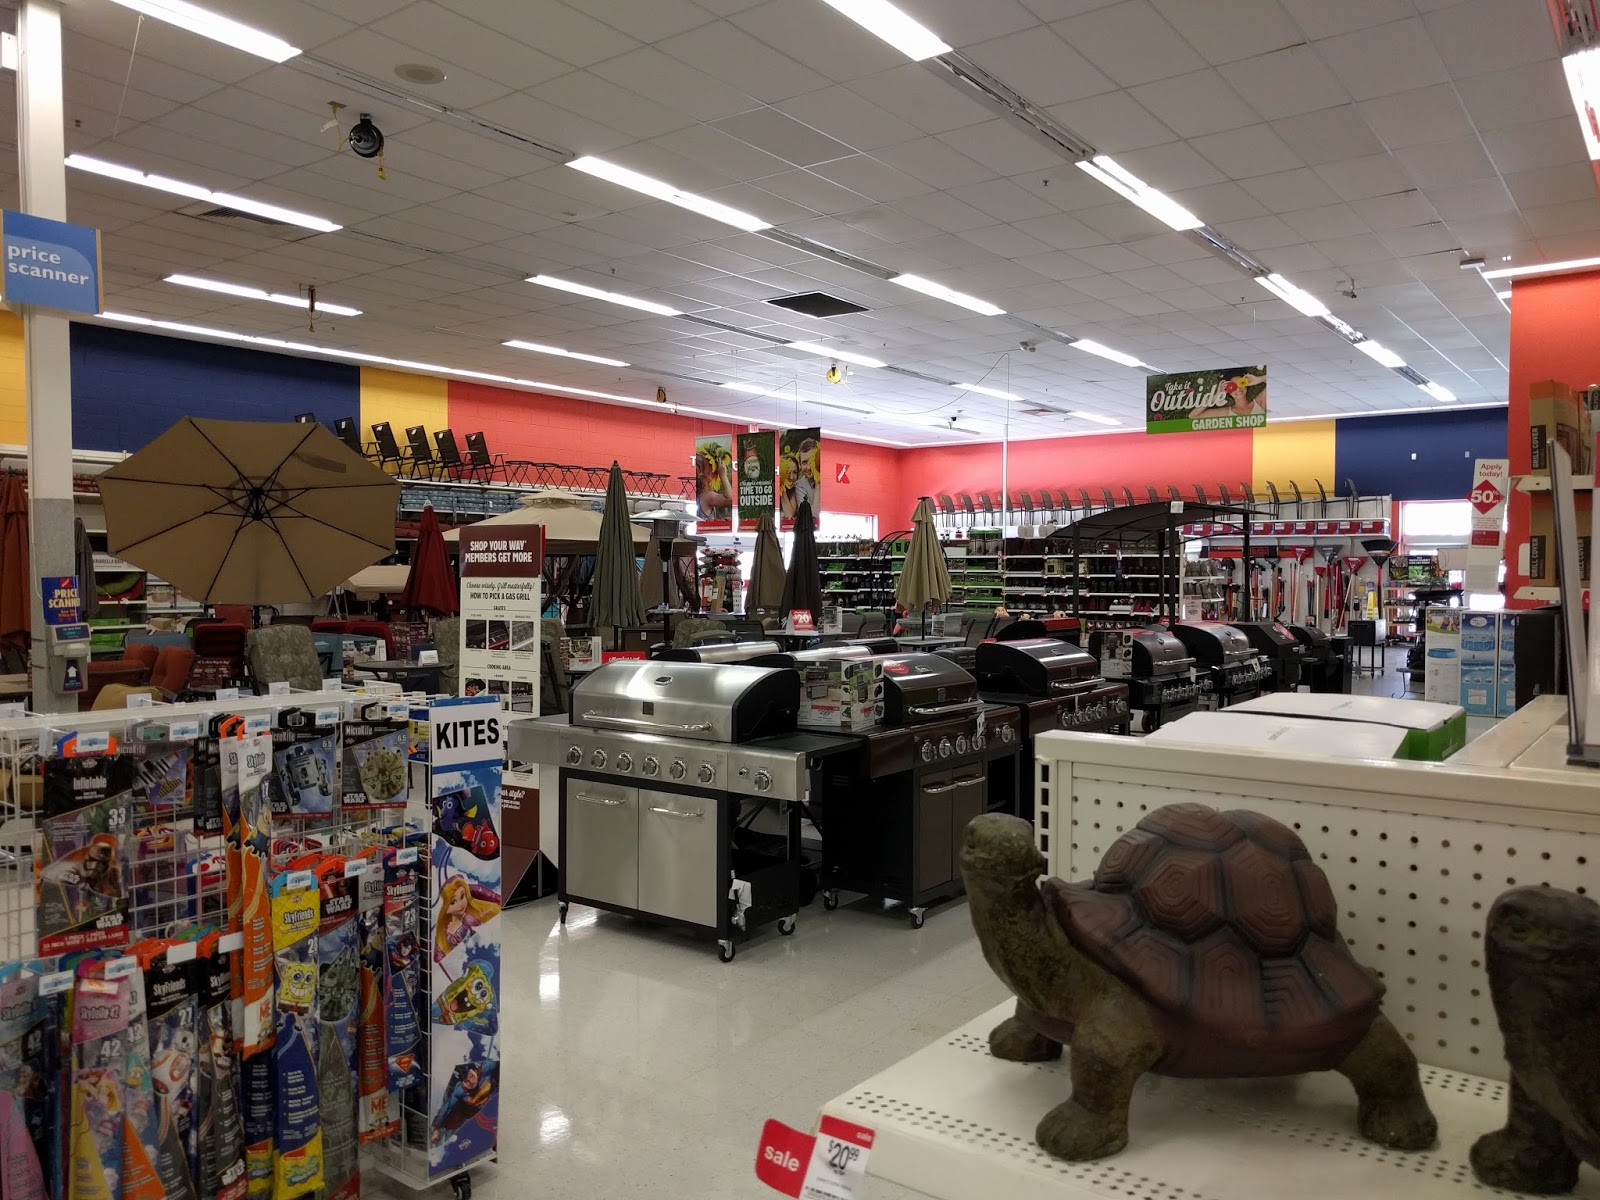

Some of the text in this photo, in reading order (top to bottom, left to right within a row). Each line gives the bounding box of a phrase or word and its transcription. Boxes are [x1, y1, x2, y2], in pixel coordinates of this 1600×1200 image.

[7, 245, 61, 264] price
[8, 262, 89, 285] scanner
[1150, 384, 1228, 412] Outside
[1192, 415, 1264, 430] GARDEN SHOP
[1479, 470, 1503, 478] today!
[1480, 463, 1503, 471] Apply
[739, 485, 772, 494] TIME TO GO
[739, 494, 773, 506] OUTSIDE
[470, 540, 525, 551] SHOP YOUR WAY
[464, 552, 533, 563] MEMBERS GET MORE
[470, 592, 481, 600] HOW
[517, 593, 530, 601] GRILL
[436, 718, 499, 749] KITES
[108, 807, 126, 826] 33
[328, 894, 353, 906] STAR
[325, 902, 352, 915] WARS
[99, 912, 125, 922] STAR
[284, 907, 314, 925] SkyFriends
[404, 908, 416, 924] 23
[96, 918, 124, 929] WARS
[153, 977, 187, 997] SkyFriends
[178, 1006, 194, 1027] 27
[100, 1039, 122, 1059] 42
[856, 1130, 872, 1142] sale
[764, 1145, 800, 1172] sale
